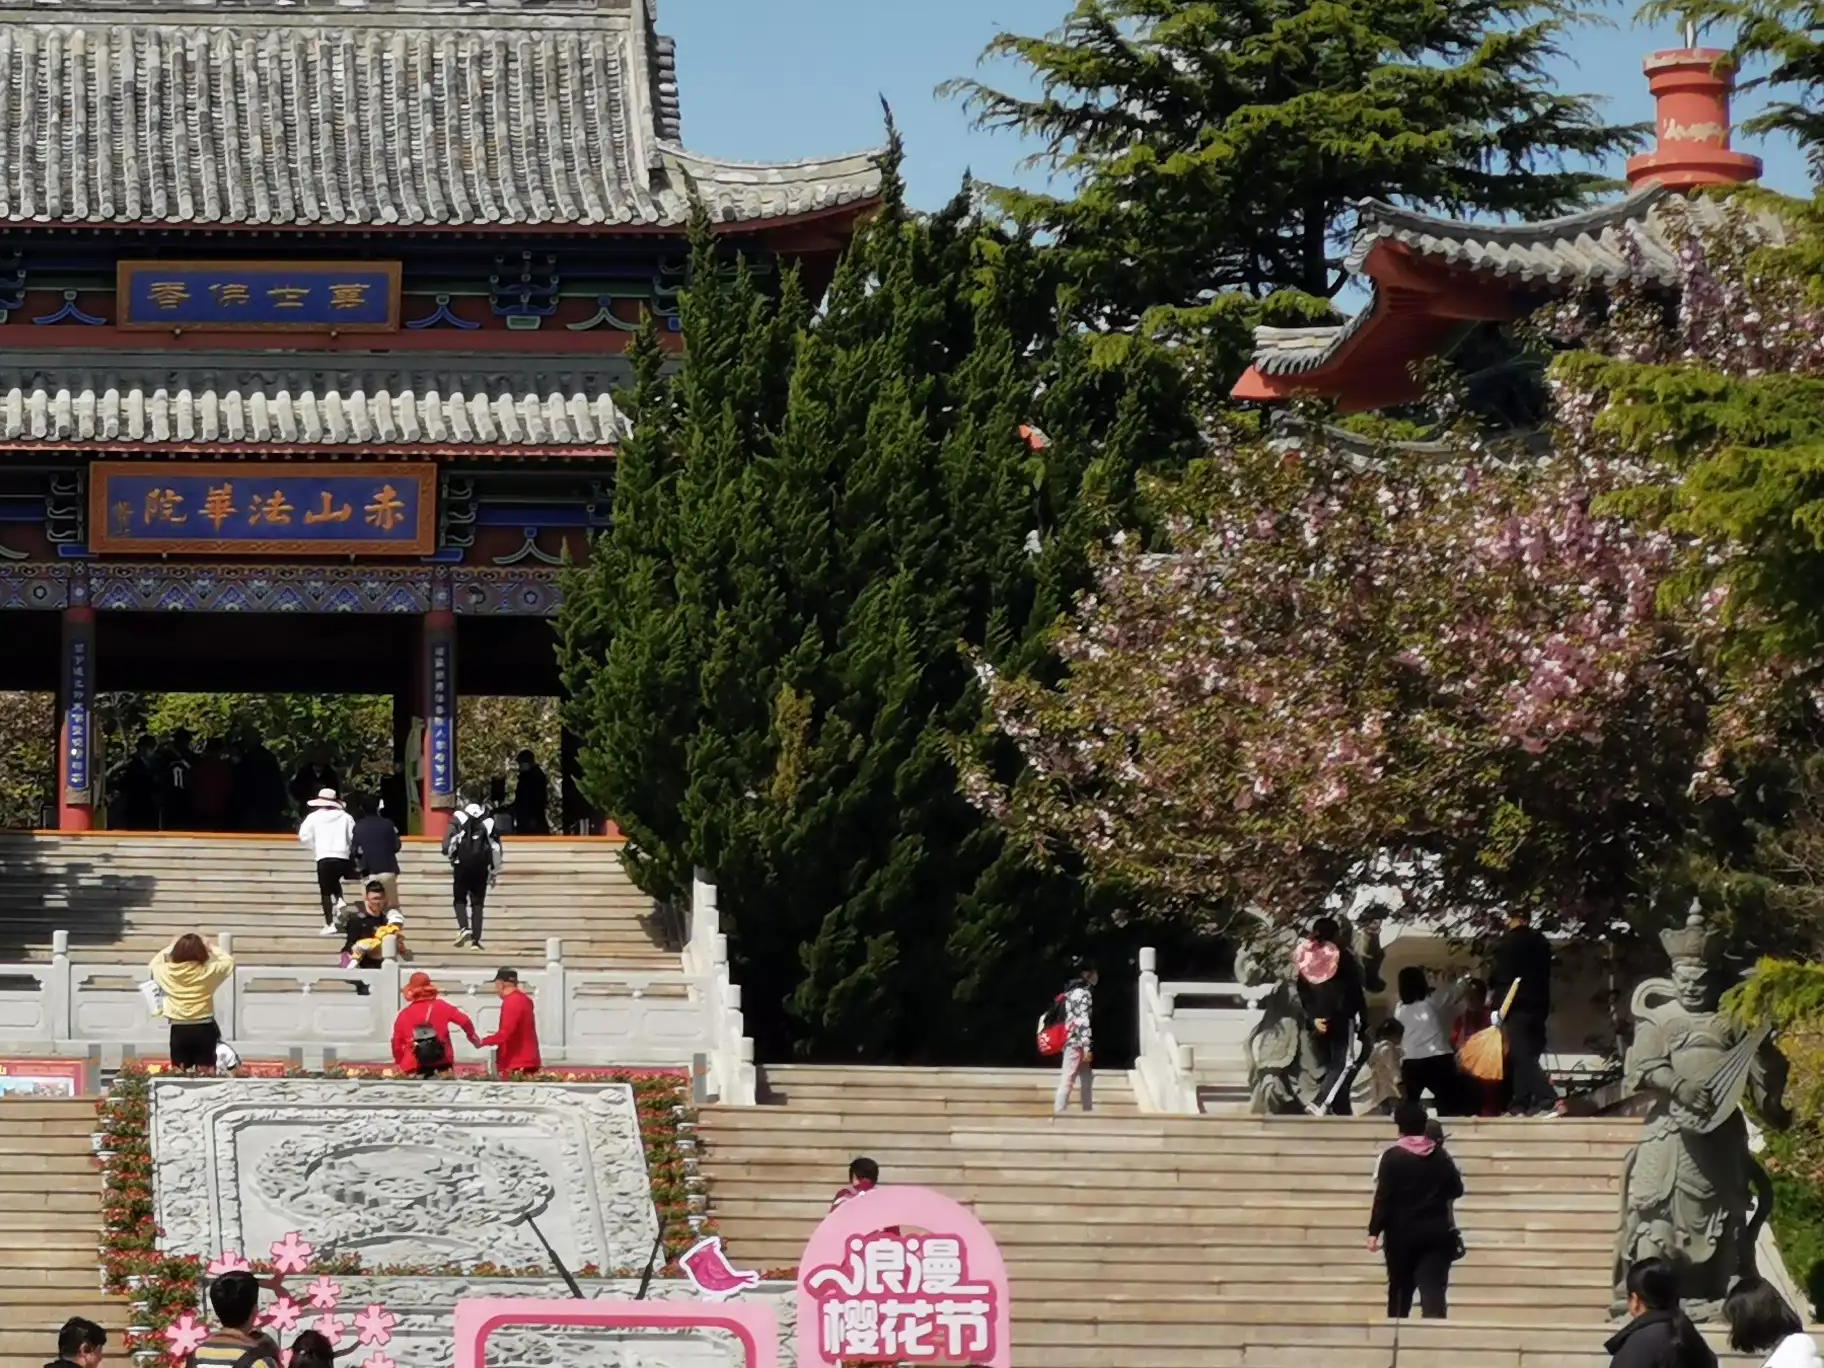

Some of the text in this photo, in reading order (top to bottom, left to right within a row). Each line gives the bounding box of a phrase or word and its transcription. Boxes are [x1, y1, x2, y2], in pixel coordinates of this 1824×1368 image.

[143, 481, 405, 531] 赤山法華院
[809, 1238, 989, 1296] 浪漫
[823, 1298, 990, 1355] 樱花节
